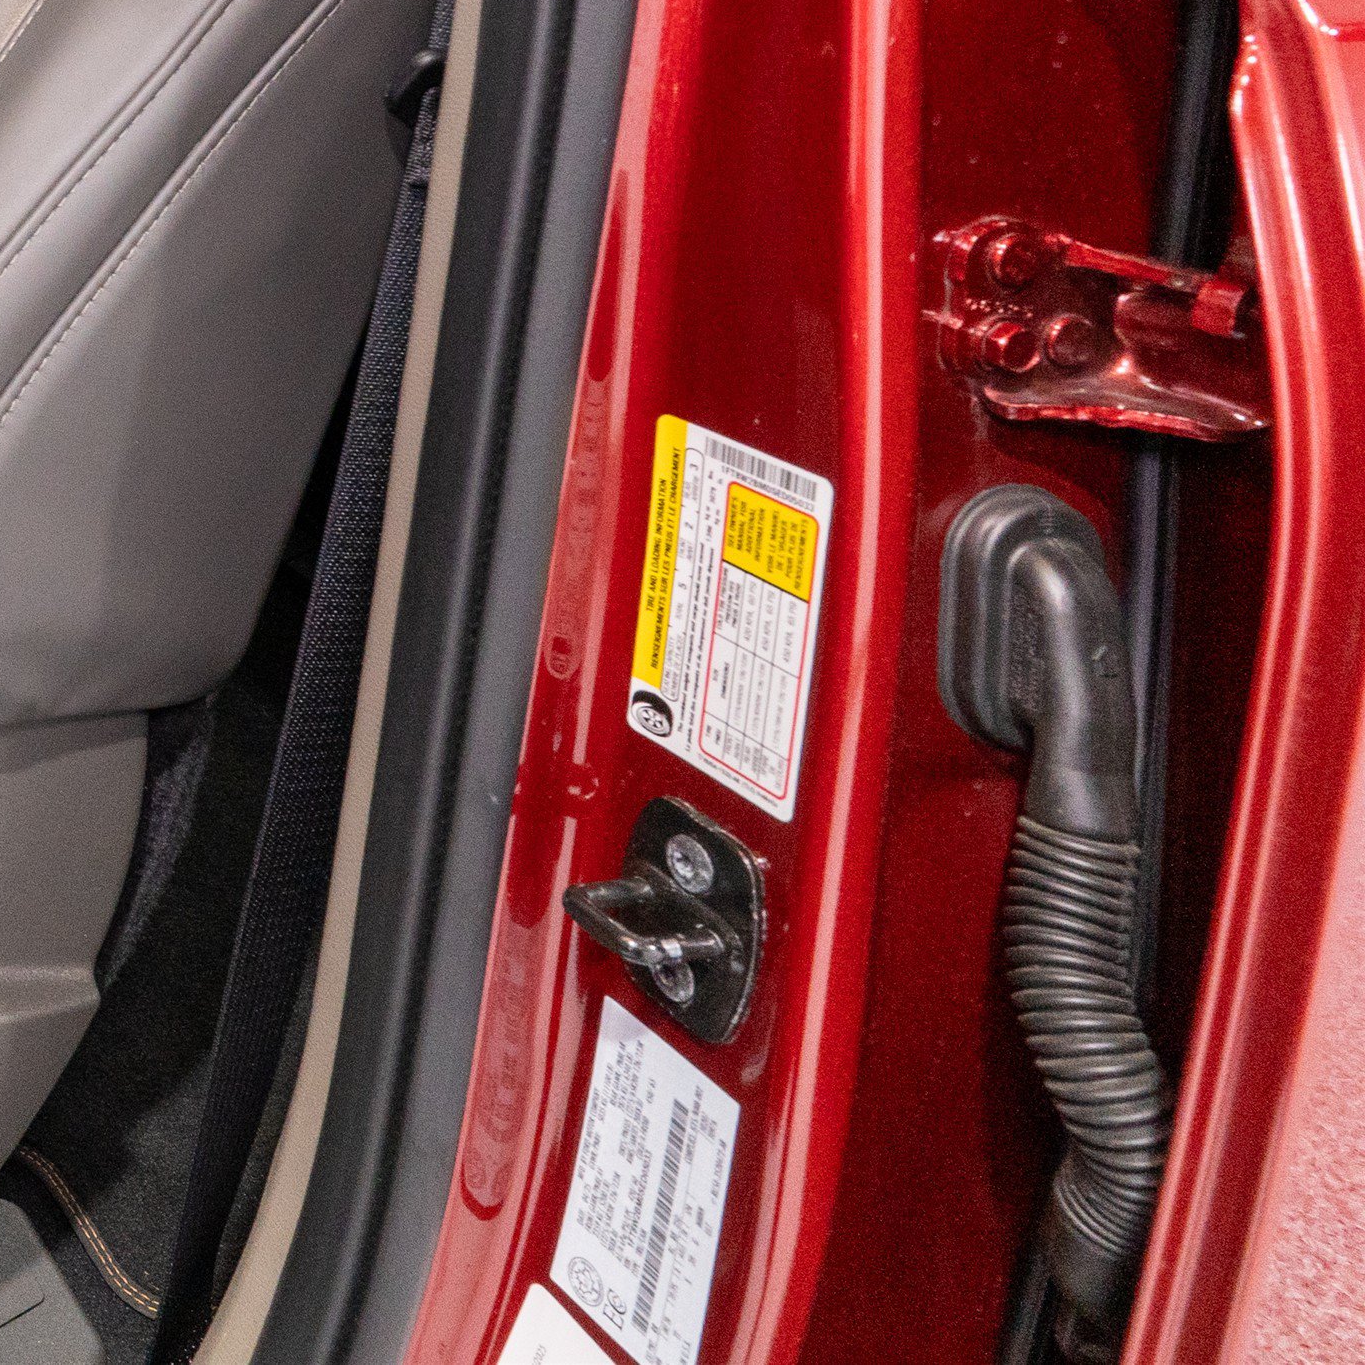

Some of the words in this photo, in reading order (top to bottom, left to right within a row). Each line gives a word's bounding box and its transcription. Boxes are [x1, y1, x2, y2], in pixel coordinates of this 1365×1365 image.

[667, 445, 681, 505] CHARGEMENT
[688, 461, 699, 471] 3
[654, 476, 668, 536] INFORMATION
[666, 504, 675, 516] LE
[665, 516, 675, 529] ET
[684, 521, 693, 530] 2
[662, 528, 673, 559] PNEUS
[650, 535, 662, 575] LOADING
[660, 557, 670, 576] LES
[648, 573, 657, 593] AND
[659, 575, 668, 594] SUR
[678, 580, 687, 591] 5
[646, 592, 655, 613] TIRE
[650, 593, 666, 670] RENSEIGNEMENTS
